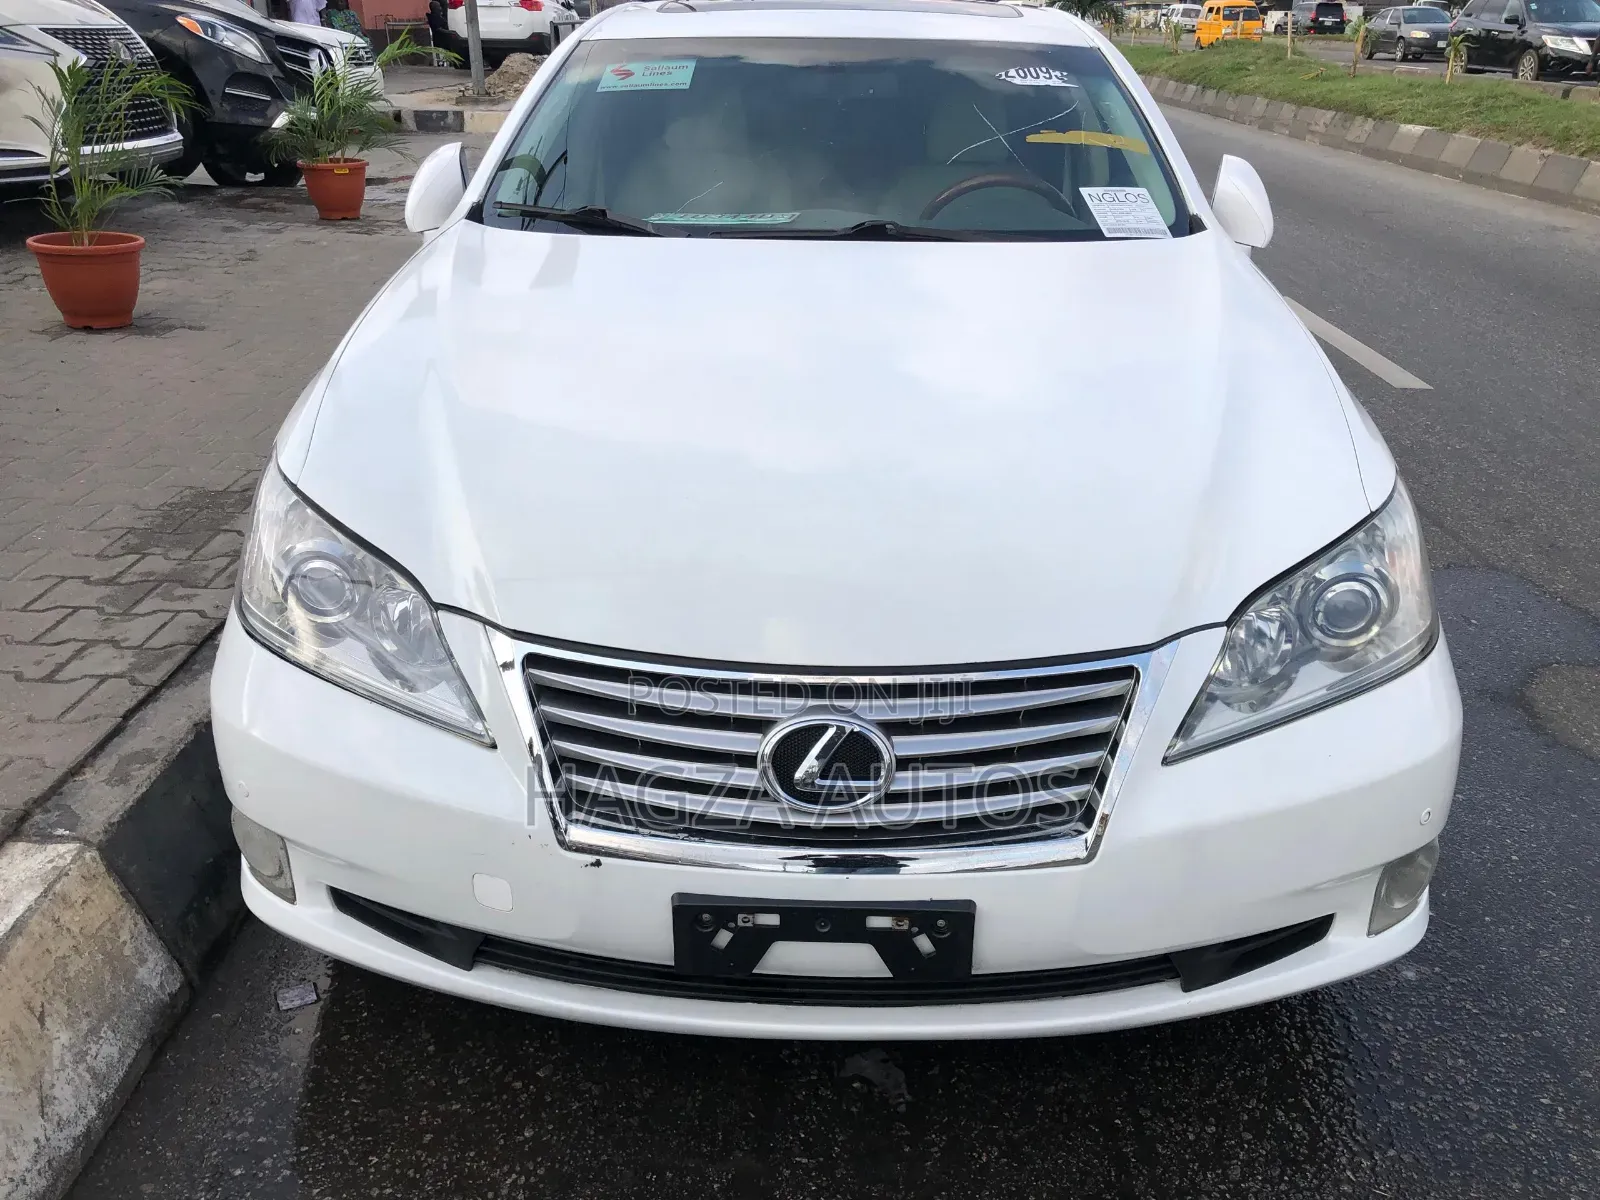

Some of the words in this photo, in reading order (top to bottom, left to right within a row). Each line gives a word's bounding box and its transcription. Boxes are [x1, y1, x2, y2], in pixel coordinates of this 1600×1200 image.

[643, 64, 689, 72] Sallaum
[600, 82, 687, 90] www.sallaumlines.com
[1088, 192, 1150, 204] NGLOS
